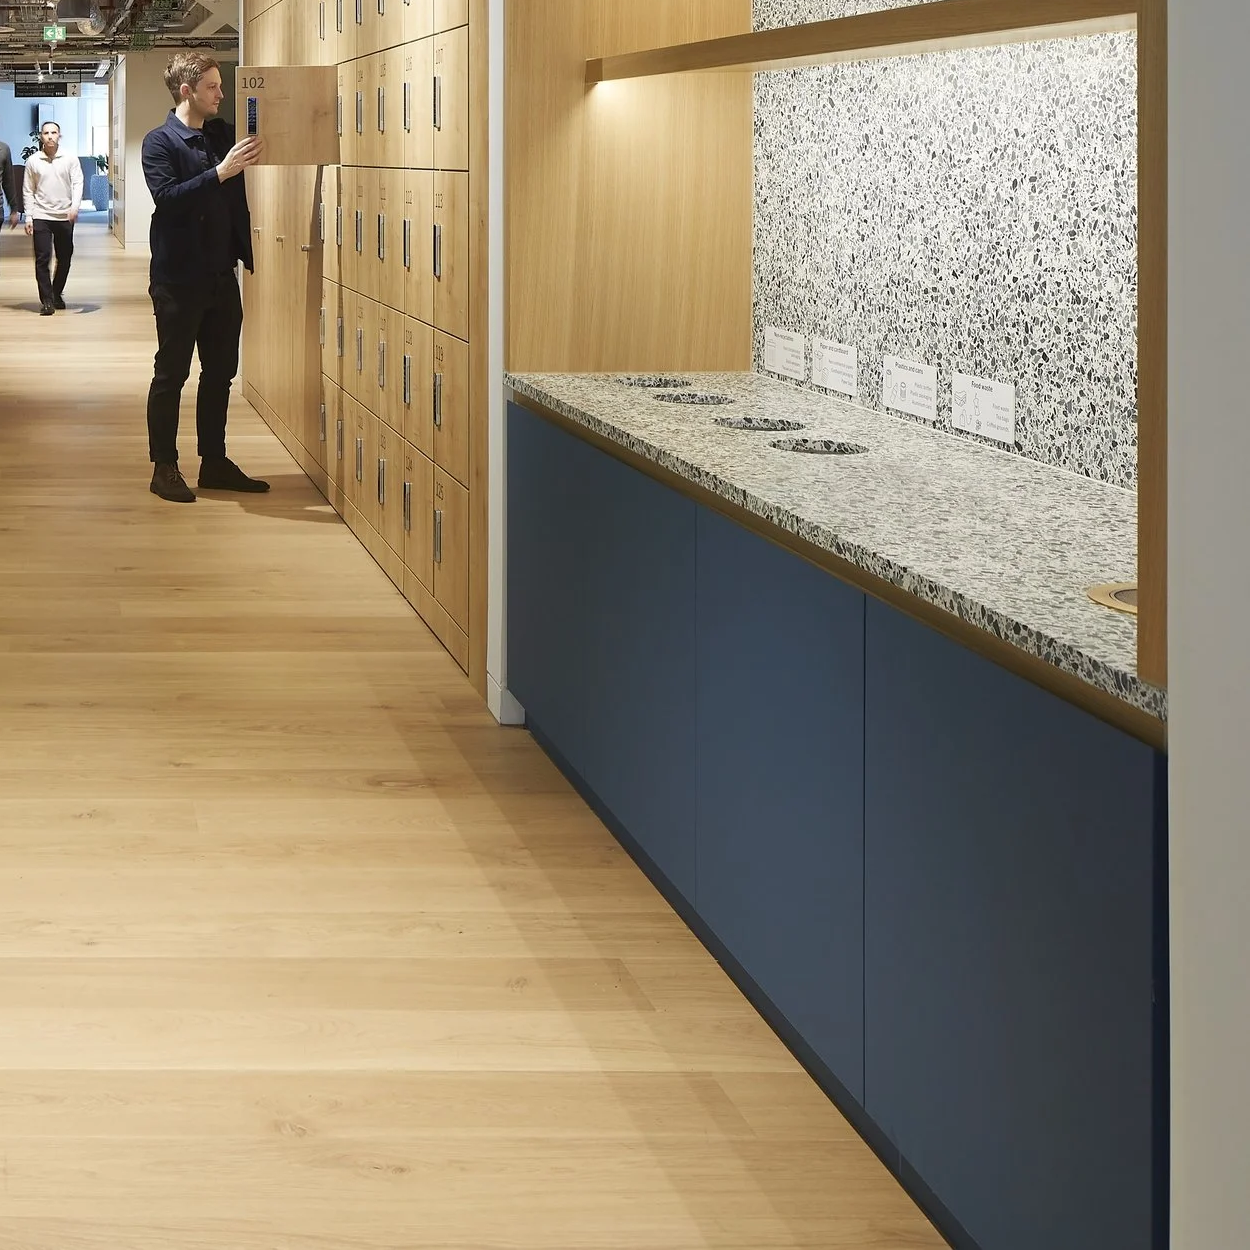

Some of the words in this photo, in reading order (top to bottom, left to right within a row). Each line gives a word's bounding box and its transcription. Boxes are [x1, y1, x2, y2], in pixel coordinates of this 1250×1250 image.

[241, 76, 266, 90] 102
[971, 380, 981, 390] Food
[981, 384, 993, 393] waste
[435, 481, 444, 501] 125
